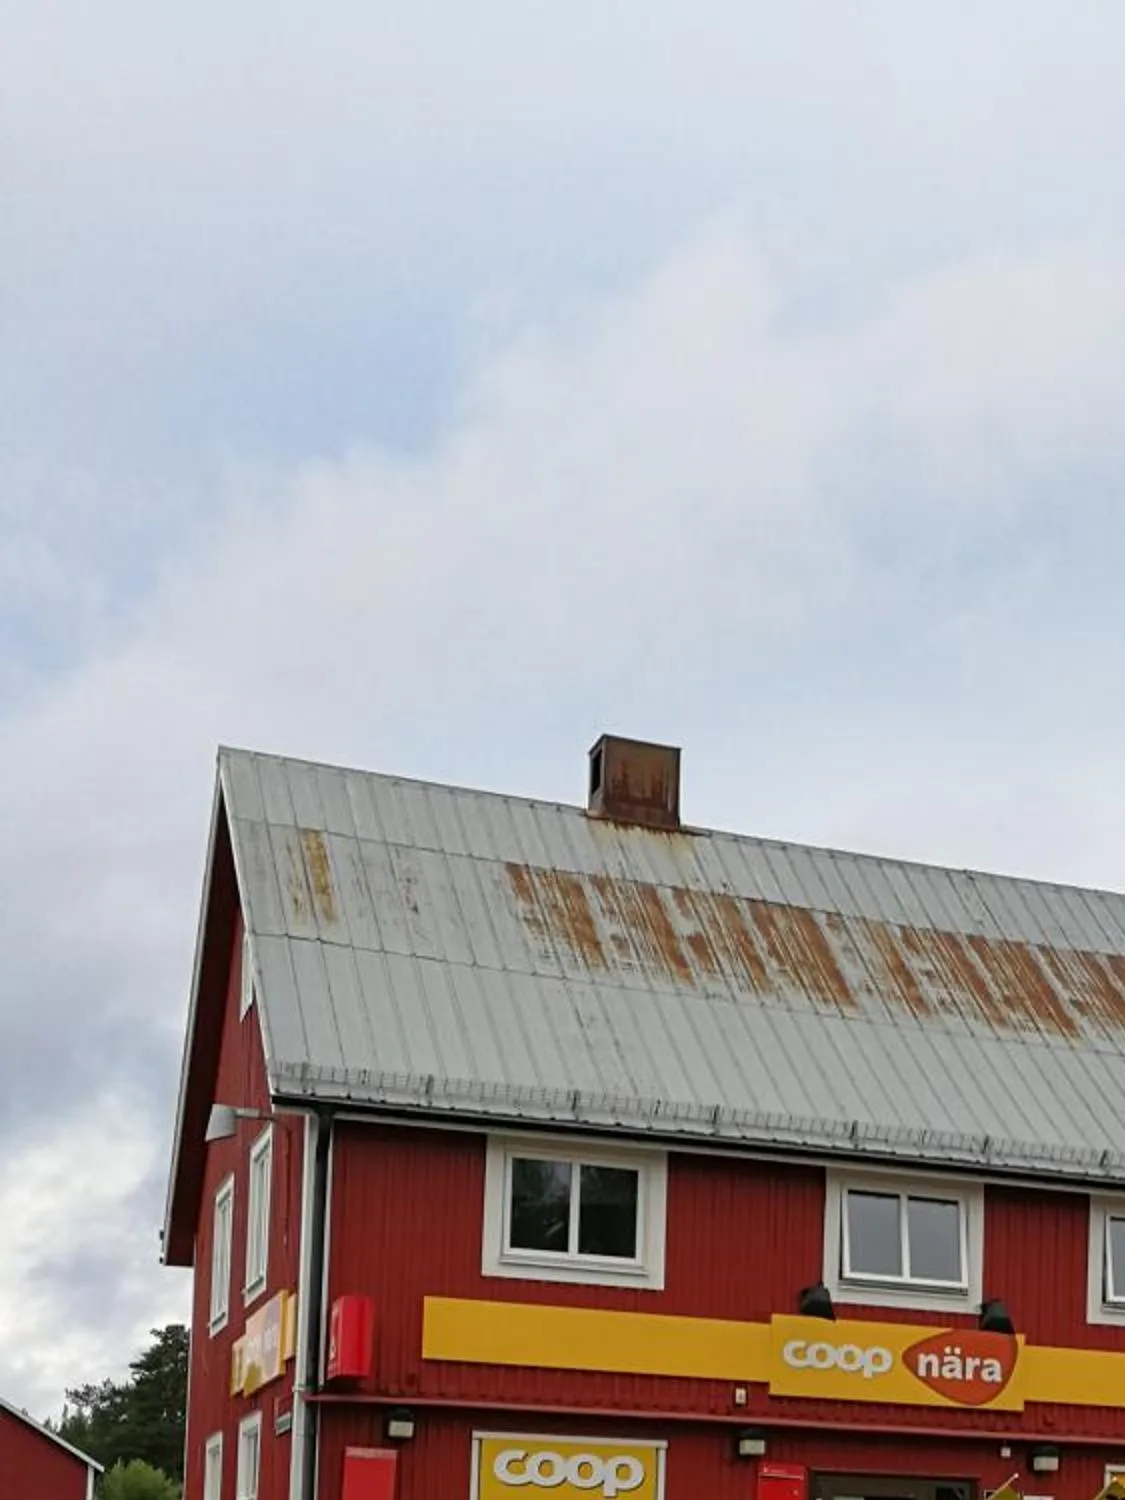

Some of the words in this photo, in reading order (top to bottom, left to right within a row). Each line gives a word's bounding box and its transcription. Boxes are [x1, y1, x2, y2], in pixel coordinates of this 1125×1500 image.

[783, 1340, 893, 1378] coop
[917, 1346, 1002, 1382] nära
[493, 1449, 645, 1498] coop
